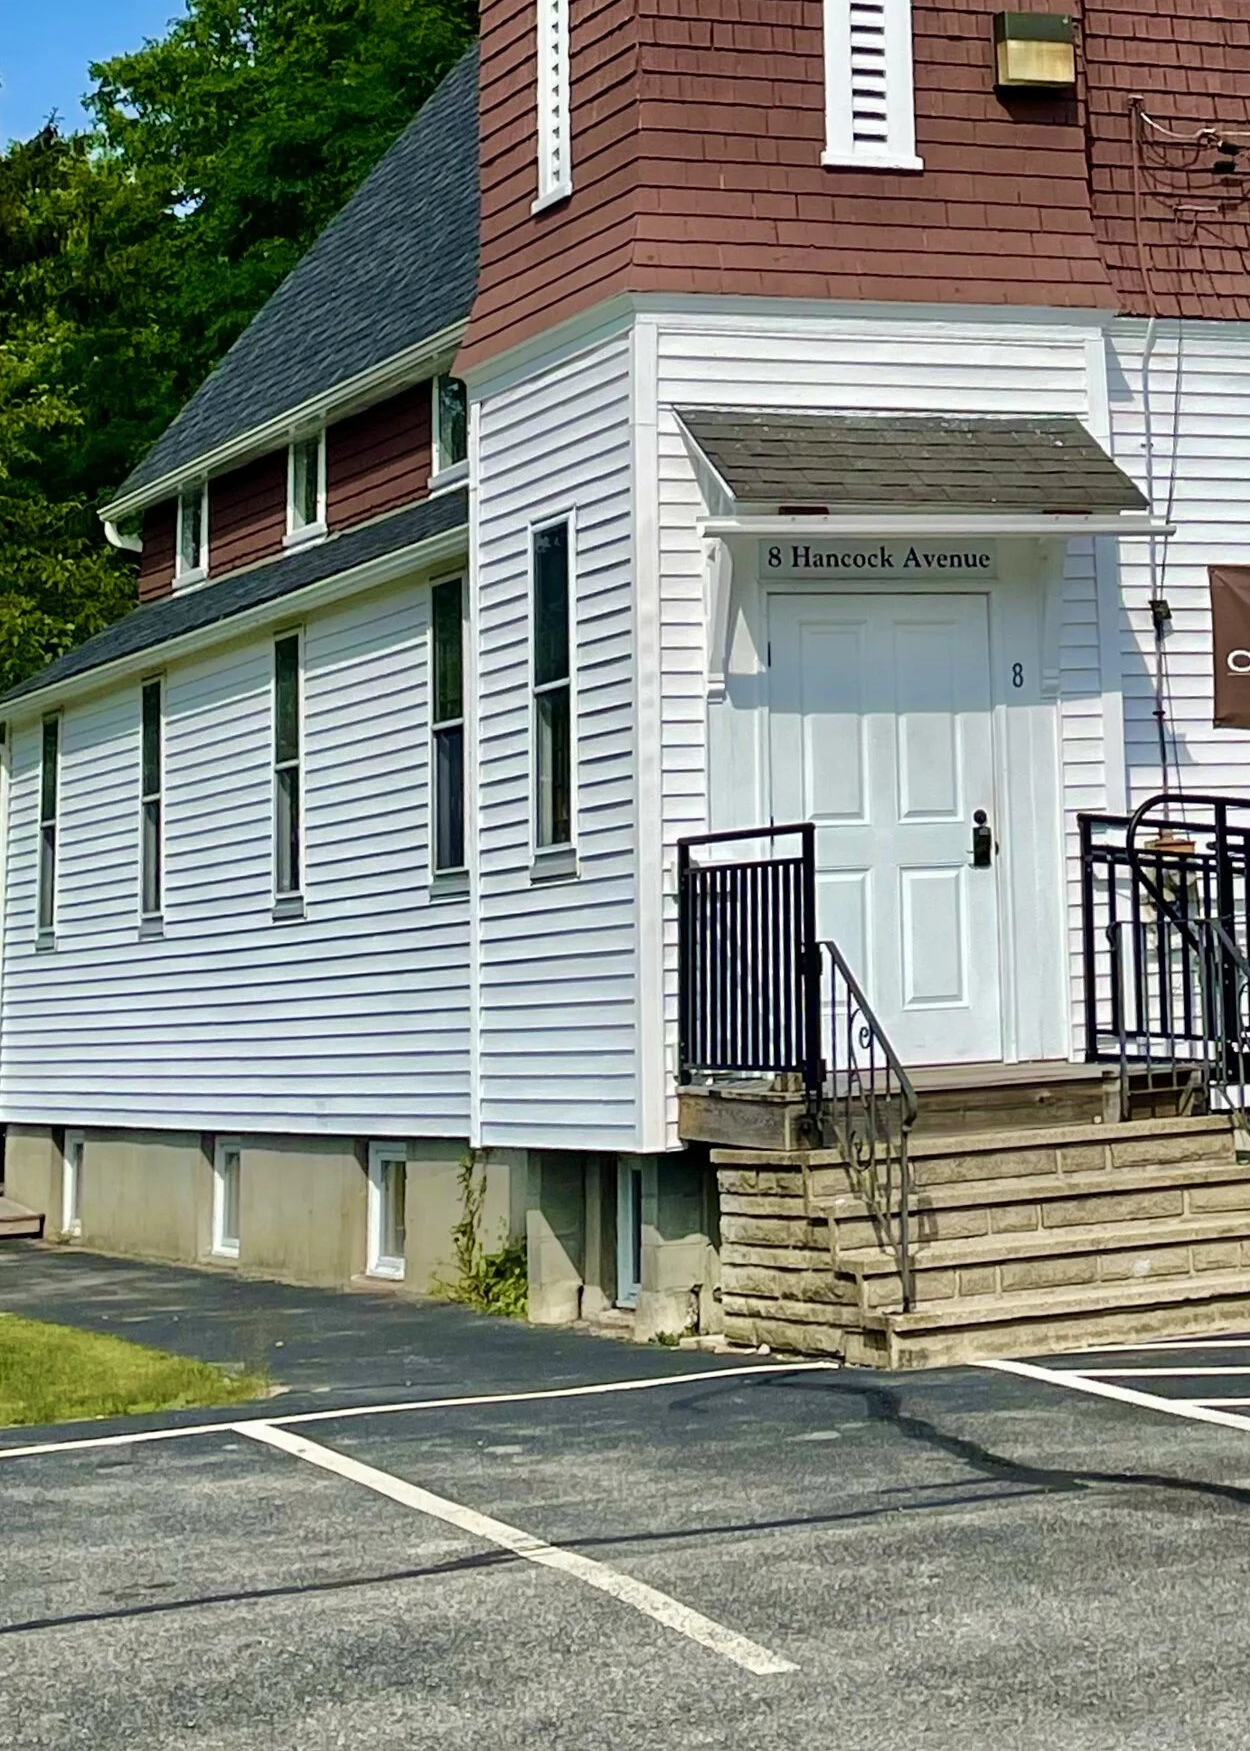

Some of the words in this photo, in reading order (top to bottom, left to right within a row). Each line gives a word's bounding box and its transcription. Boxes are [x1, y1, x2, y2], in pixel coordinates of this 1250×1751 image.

[768, 545, 782, 568] 8
[791, 545, 894, 569] Hancock
[902, 546, 991, 569] Avenue
[1011, 662, 1024, 688] 8
